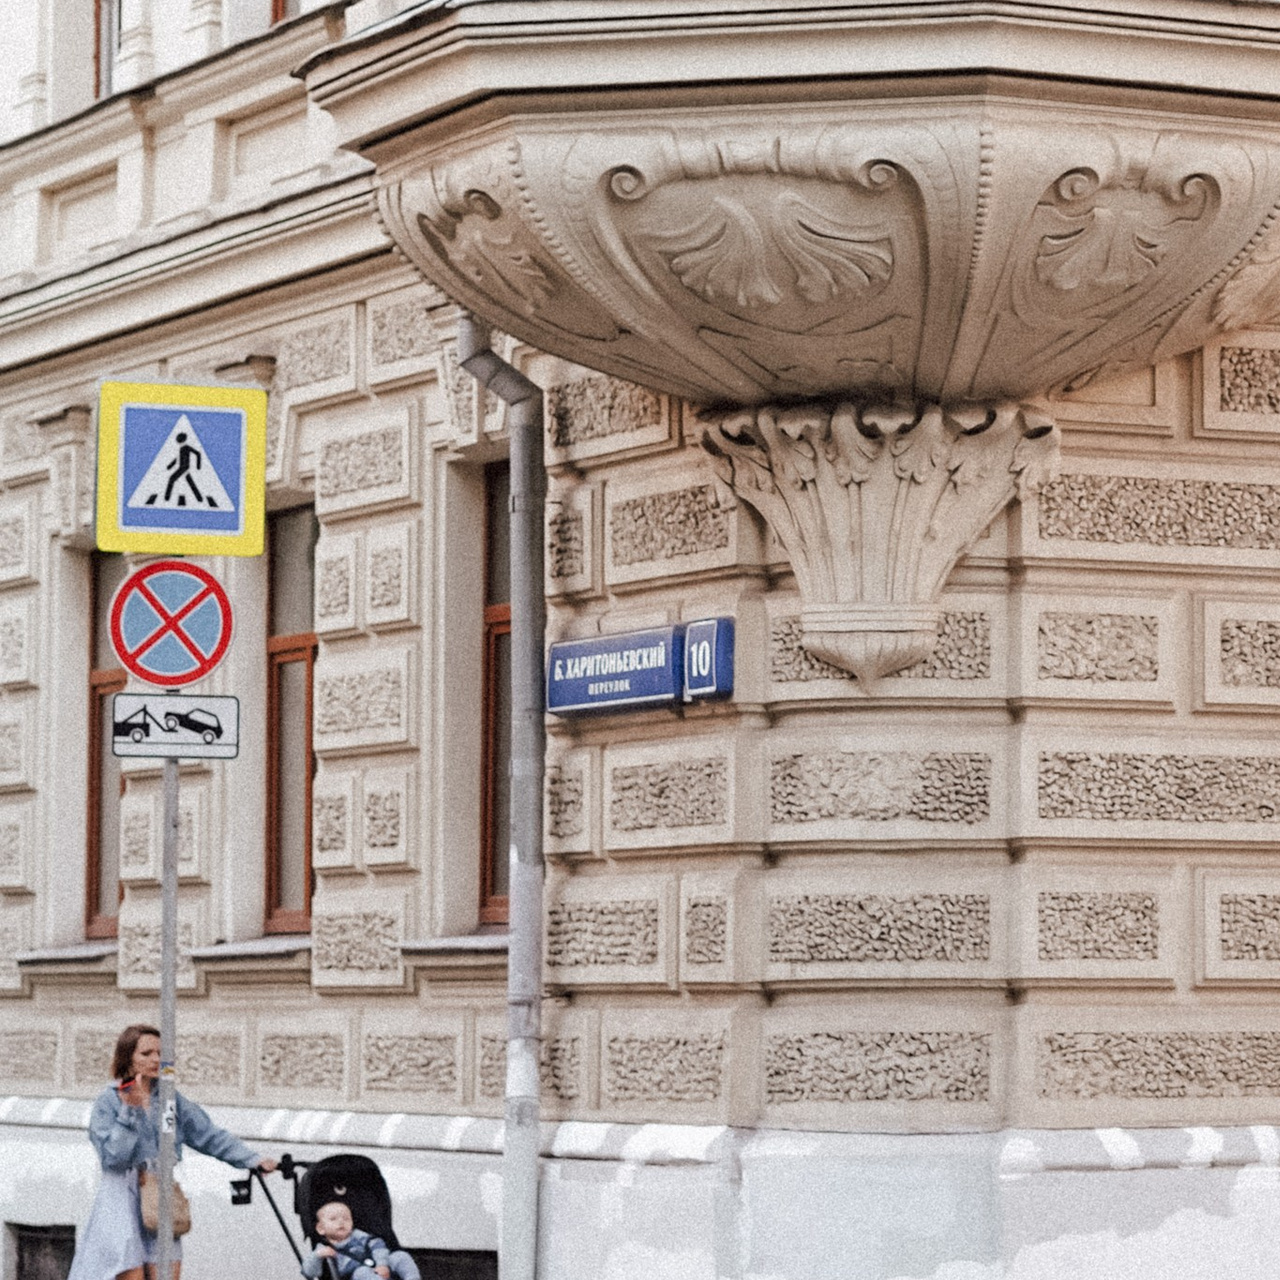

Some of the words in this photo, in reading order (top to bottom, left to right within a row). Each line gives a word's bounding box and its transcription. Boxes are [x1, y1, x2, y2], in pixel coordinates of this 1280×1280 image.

[565, 641, 666, 679] ХАРИТОНЬЕВСКИЙ
[691, 640, 711, 677] 10
[588, 679, 631, 695] ПЕРЕУЛОК
